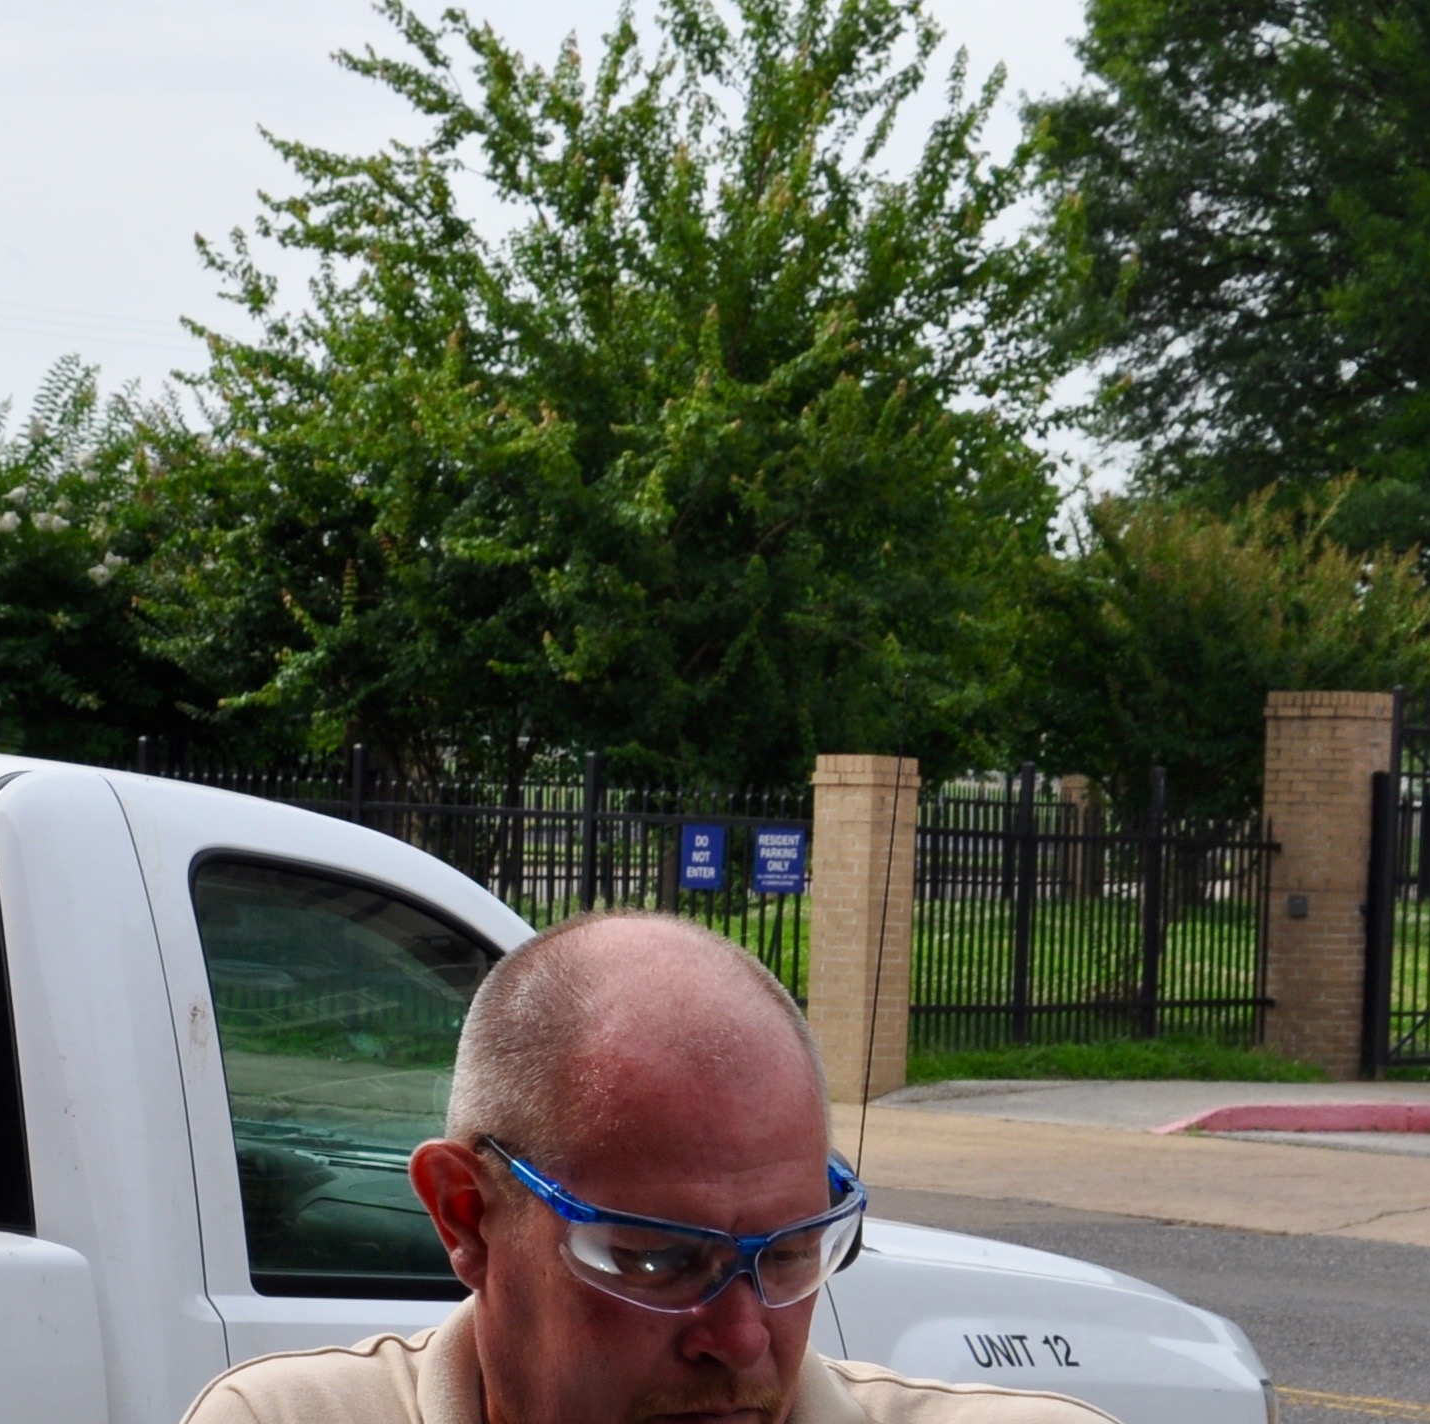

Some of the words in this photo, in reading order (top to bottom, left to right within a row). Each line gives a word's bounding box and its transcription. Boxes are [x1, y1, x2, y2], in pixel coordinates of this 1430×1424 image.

[695, 835, 709, 847] DO
[758, 834, 801, 846] RESIDENT
[692, 851, 711, 863] NOT
[760, 847, 798, 859] PARKING
[767, 860, 790, 872] ONLY
[686, 866, 715, 879] ENTER
[963, 1334, 1036, 1368] UNIT
[1042, 1334, 1080, 1367] 12
